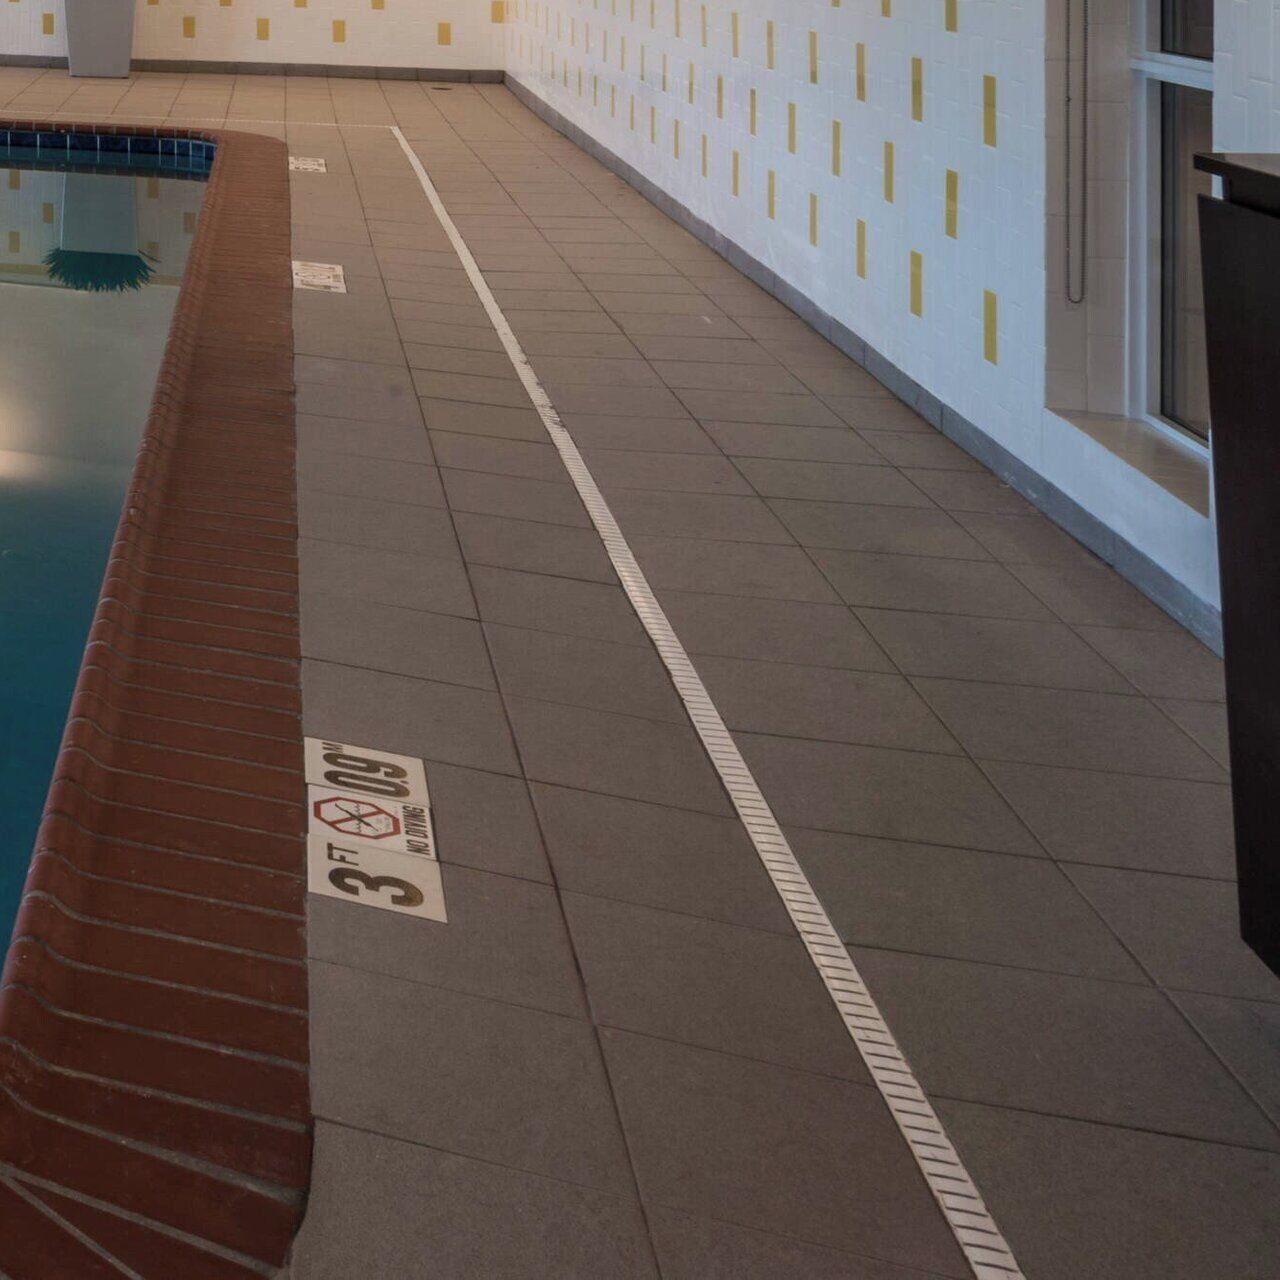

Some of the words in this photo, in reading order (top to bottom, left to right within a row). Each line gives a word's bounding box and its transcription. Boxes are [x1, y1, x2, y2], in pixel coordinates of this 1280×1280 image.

[322, 752, 410, 799] 0.9
[402, 805, 428, 839] DIVING
[326, 842, 359, 866] FT
[406, 839, 431, 856] NO
[328, 866, 424, 908] 3
